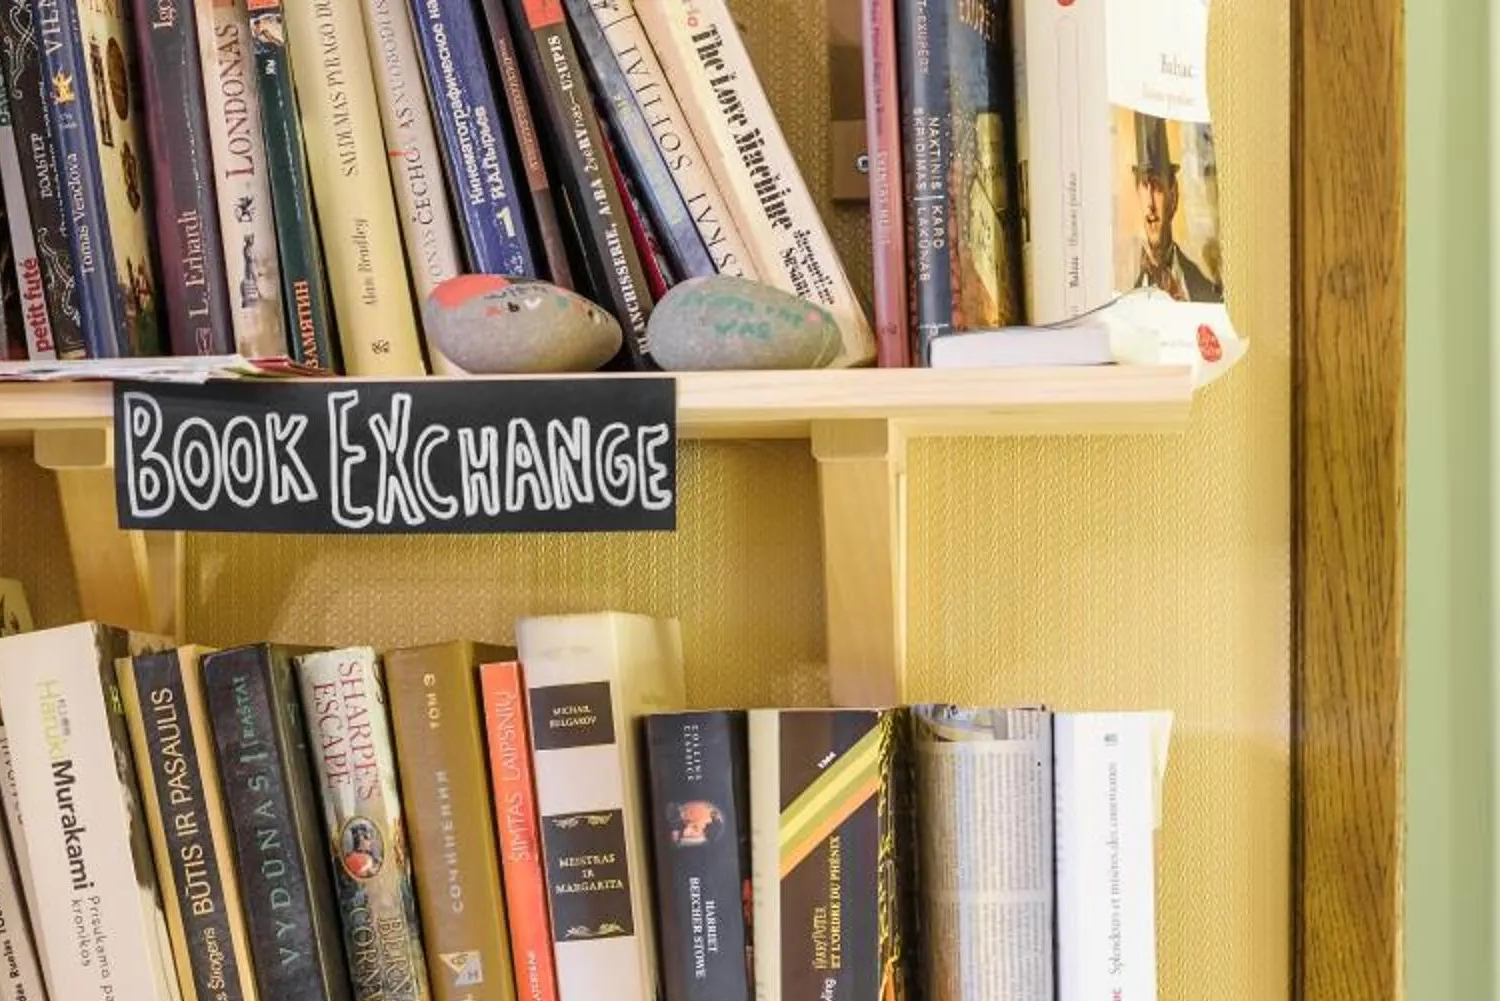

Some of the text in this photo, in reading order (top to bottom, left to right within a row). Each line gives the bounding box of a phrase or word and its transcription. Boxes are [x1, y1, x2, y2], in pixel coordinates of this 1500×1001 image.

[214, 23, 256, 180] LONDONAS
[62, 152, 86, 219] Venclova
[926, 116, 941, 191] NAKTINIS
[74, 224, 95, 275] Tomas
[931, 205, 946, 250] KARO
[26, 302, 52, 353] petit
[122, 390, 672, 528] BOOK EXCHANGE
[151, 686, 194, 807] PASAULIS
[312, 683, 352, 790] ESCAPE
[51, 759, 96, 892] Murakami
[176, 810, 198, 838] IR
[181, 847, 215, 916] BŪTIS
[248, 774, 303, 967] VYDŪNAS
[555, 879, 624, 895] MARGARITA
[830, 884, 840, 899] DU
[72, 896, 92, 968] kronikos
[89, 895, 111, 980] Prisukamo
